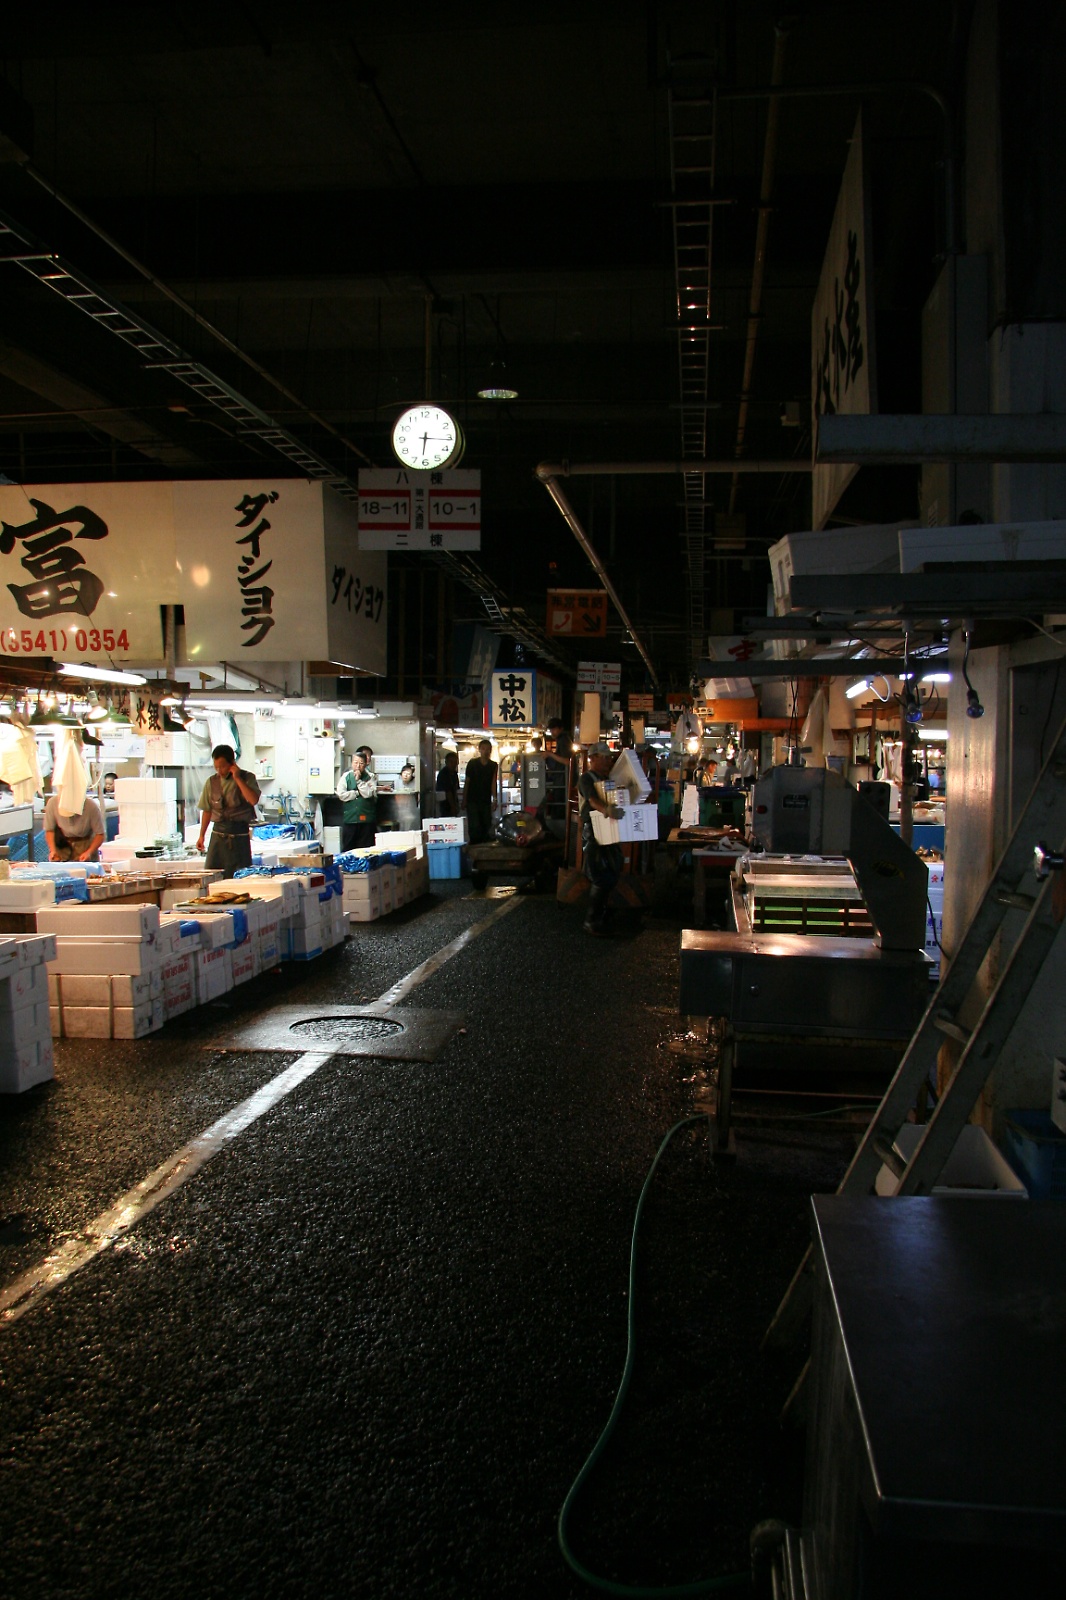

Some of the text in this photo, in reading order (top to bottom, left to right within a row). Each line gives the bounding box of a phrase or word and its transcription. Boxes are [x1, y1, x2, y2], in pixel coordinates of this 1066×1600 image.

[442, 422, 449, 430] 2
[401, 447, 409, 455] 8
[421, 458, 430, 466] 6
[430, 471, 443, 485] 棟
[361, 501, 407, 515] 18-11
[432, 502, 476, 515] 10-1
[429, 533, 443, 547] 棟
[0, 498, 109, 619] 富
[75, 629, 130, 651] 0354
[499, 673, 527, 722] 中松
